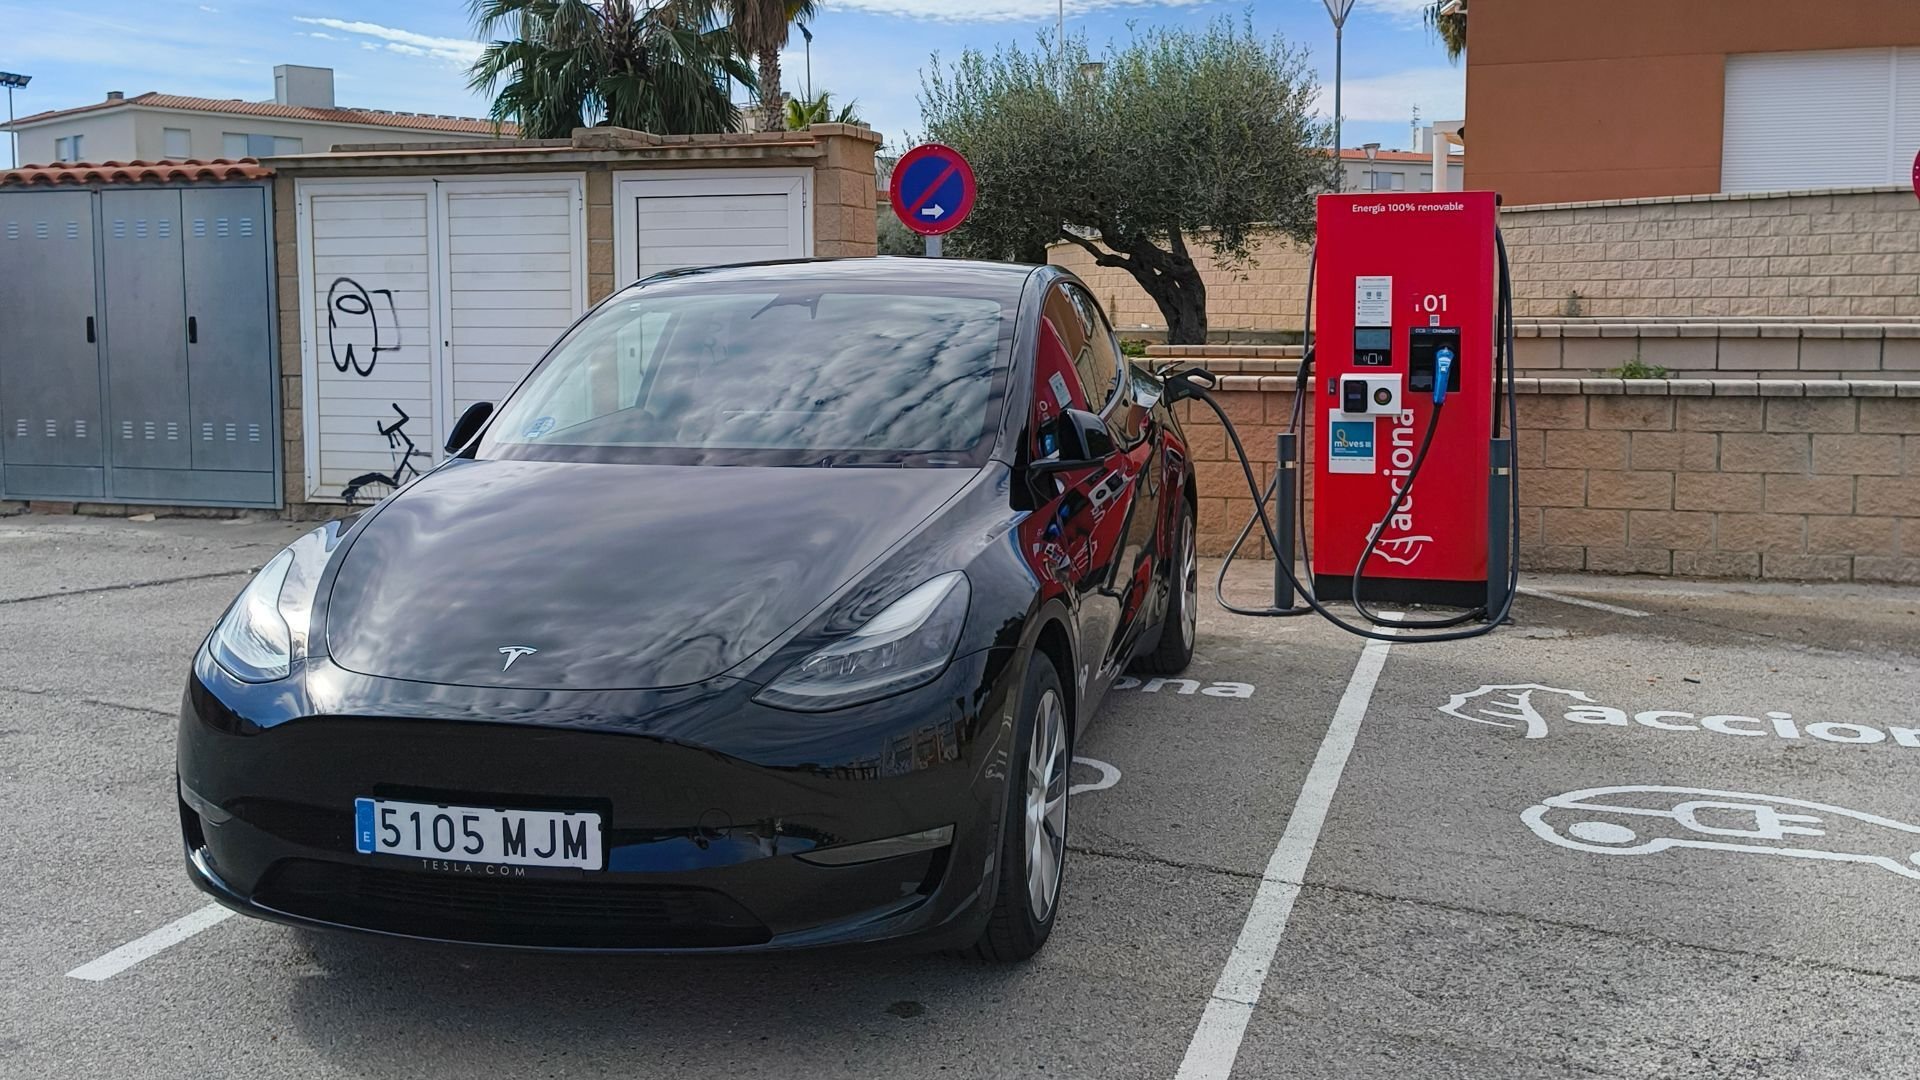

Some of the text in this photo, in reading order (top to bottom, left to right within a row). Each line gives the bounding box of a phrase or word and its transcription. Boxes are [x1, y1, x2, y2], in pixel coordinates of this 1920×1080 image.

[1352, 202, 1464, 215] Energía 100% renovable
[1423, 294, 1447, 312] 01
[1383, 409, 1414, 531] acciona
[363, 832, 371, 842] E
[381, 808, 587, 859] 5105 MJM
[422, 859, 526, 877] TESLA.COM
